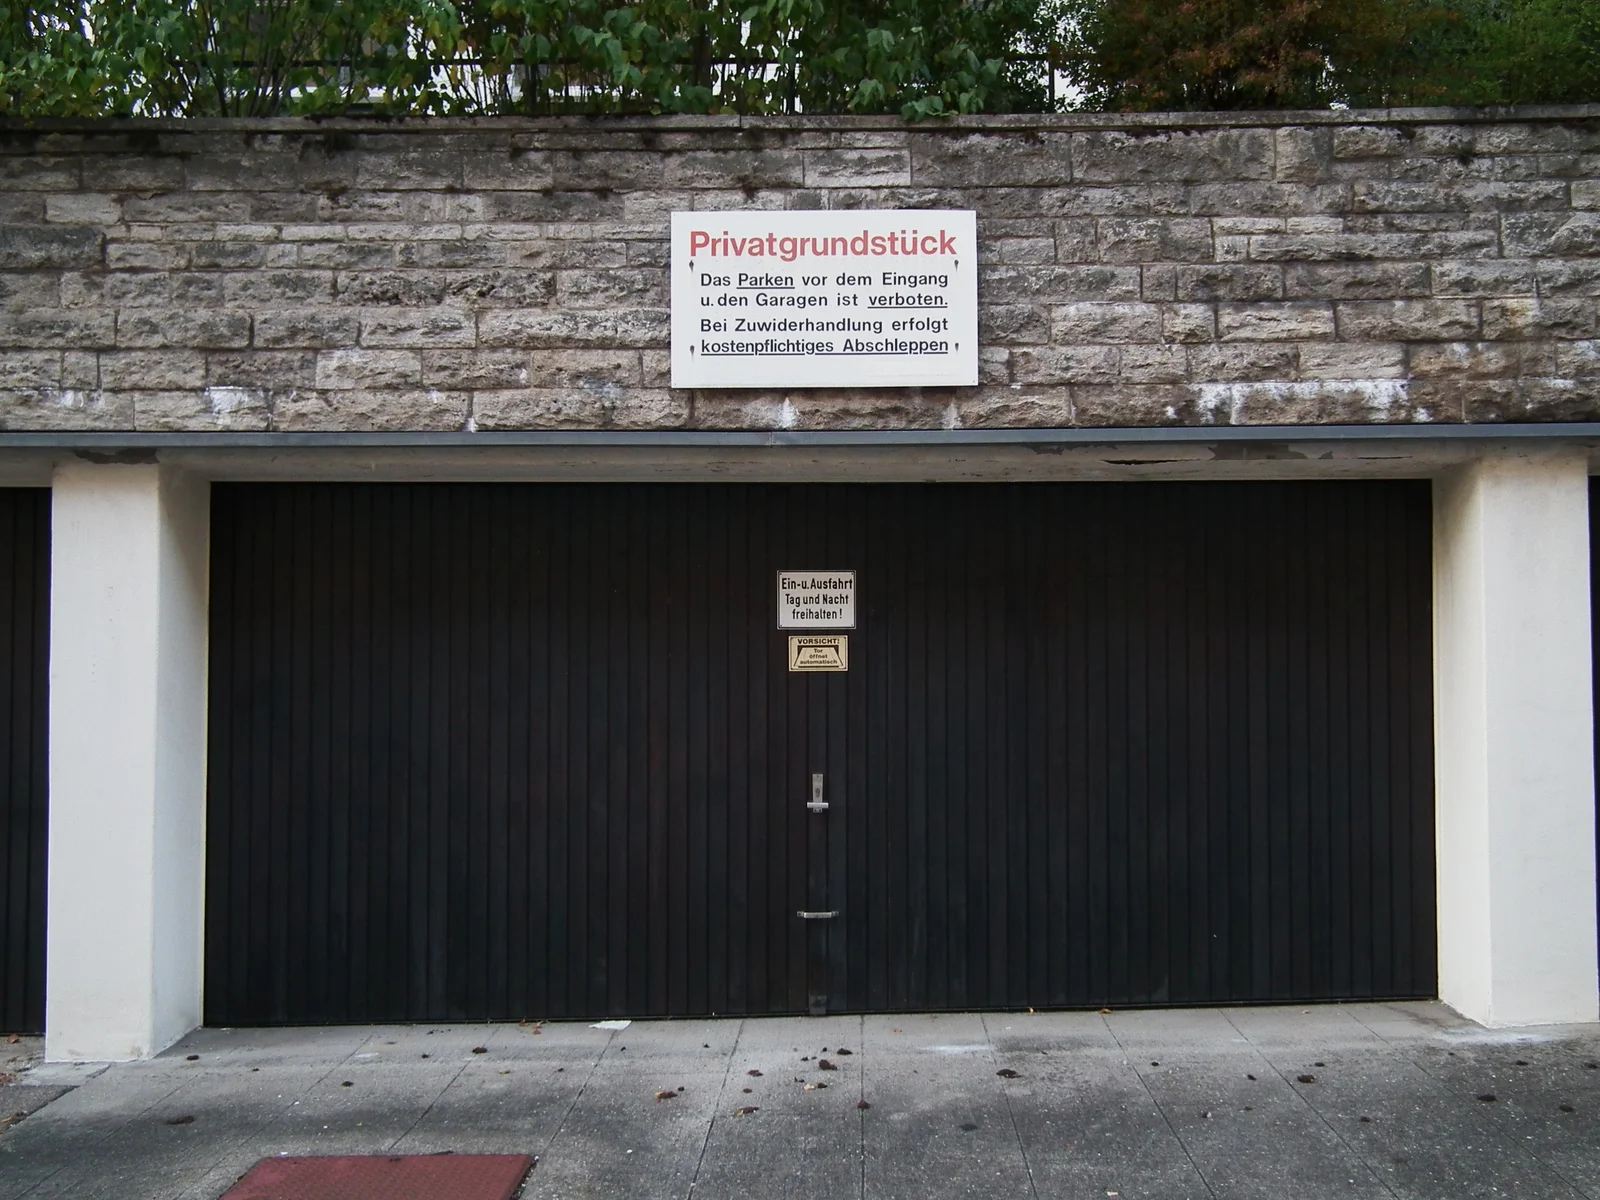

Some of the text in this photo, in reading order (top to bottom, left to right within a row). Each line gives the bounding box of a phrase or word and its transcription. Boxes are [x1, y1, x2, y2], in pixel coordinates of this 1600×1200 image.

[689, 229, 958, 263] Privatgrundstück
[700, 271, 949, 289] Das Parken vor dem Eingang
[755, 292, 829, 309] Garagen
[836, 292, 859, 307] ist
[868, 292, 949, 306] verboten.
[700, 316, 949, 334] Bei Zuwiderhandlung erfolgt
[700, 337, 950, 356] kostenpflichtiges Abschleppen
[785, 593, 849, 608] Tag und Nacht
